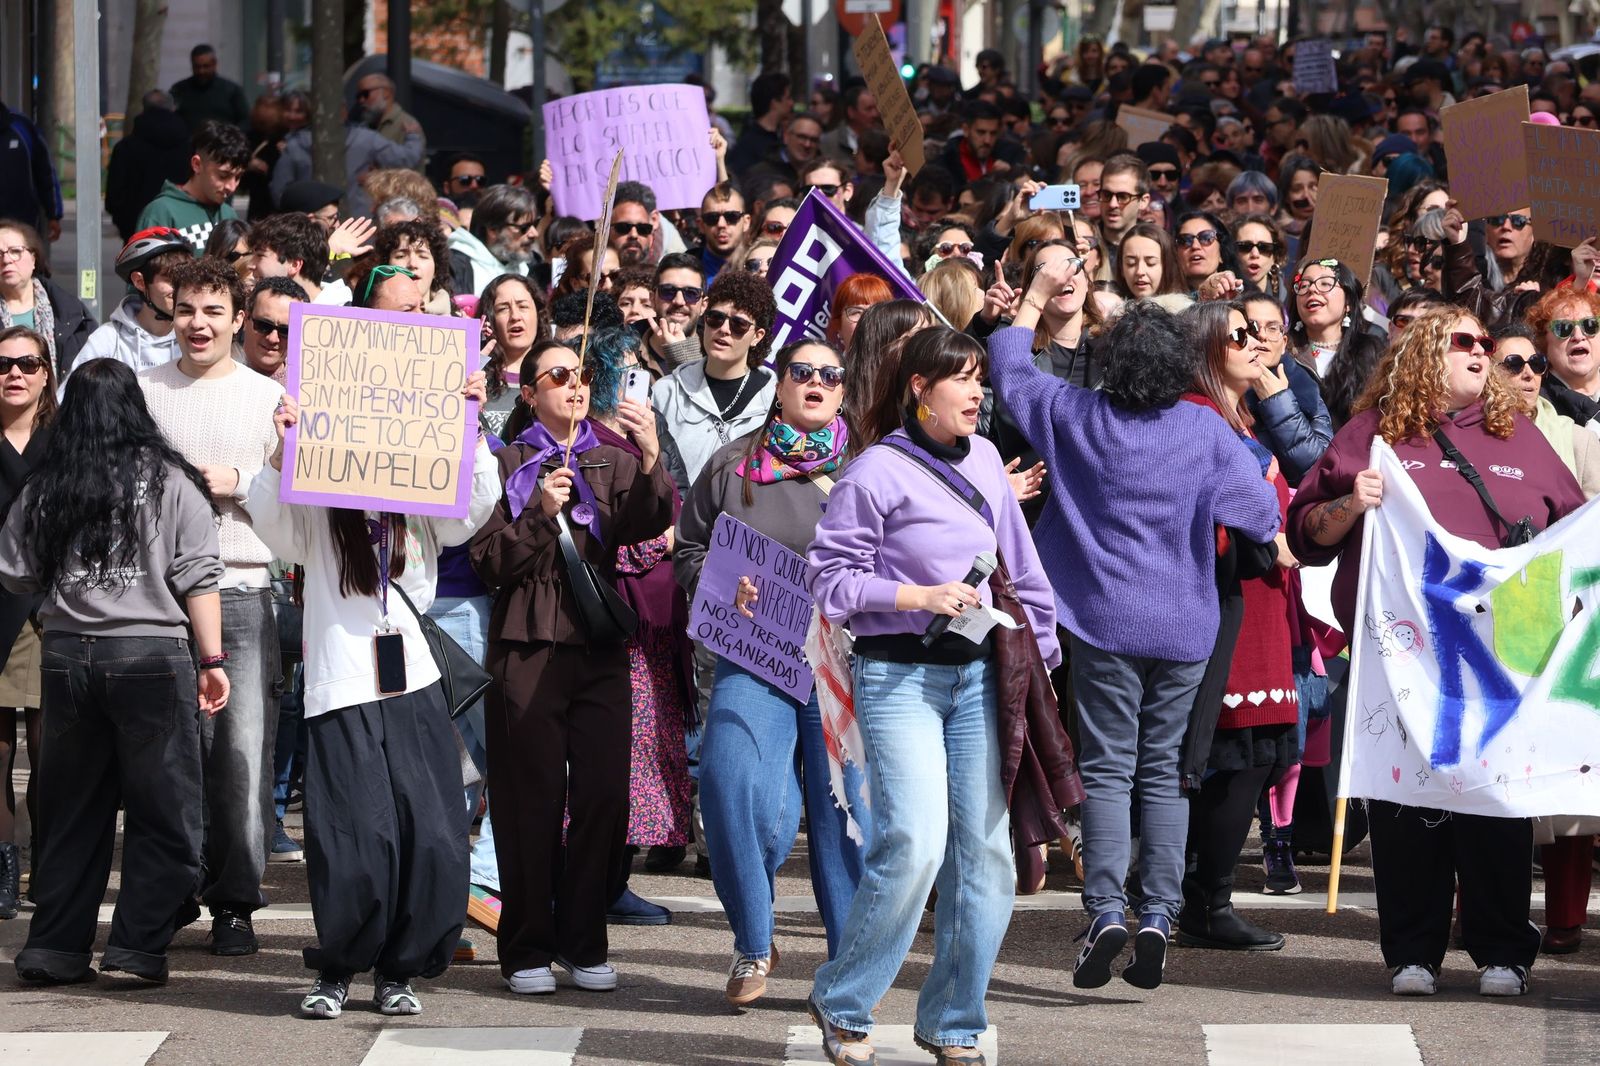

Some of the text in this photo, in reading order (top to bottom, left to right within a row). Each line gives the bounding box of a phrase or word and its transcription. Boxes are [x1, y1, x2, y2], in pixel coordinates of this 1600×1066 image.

[606, 93, 640, 117] LAS
[561, 133, 585, 156] LO
[564, 163, 587, 187] EN
[302, 317, 352, 349] CON
[394, 357, 464, 393] VELO
[300, 410, 456, 452] NO ME TOCAS
[328, 448, 371, 482] UN
[374, 451, 452, 490] PELO
[739, 529, 769, 566] NOS
[774, 550, 809, 593] QUIER
[748, 574, 814, 638] ENFRENTA
[701, 600, 807, 665] NOS TRENDR
[697, 622, 801, 688] ORGANIZADAS
